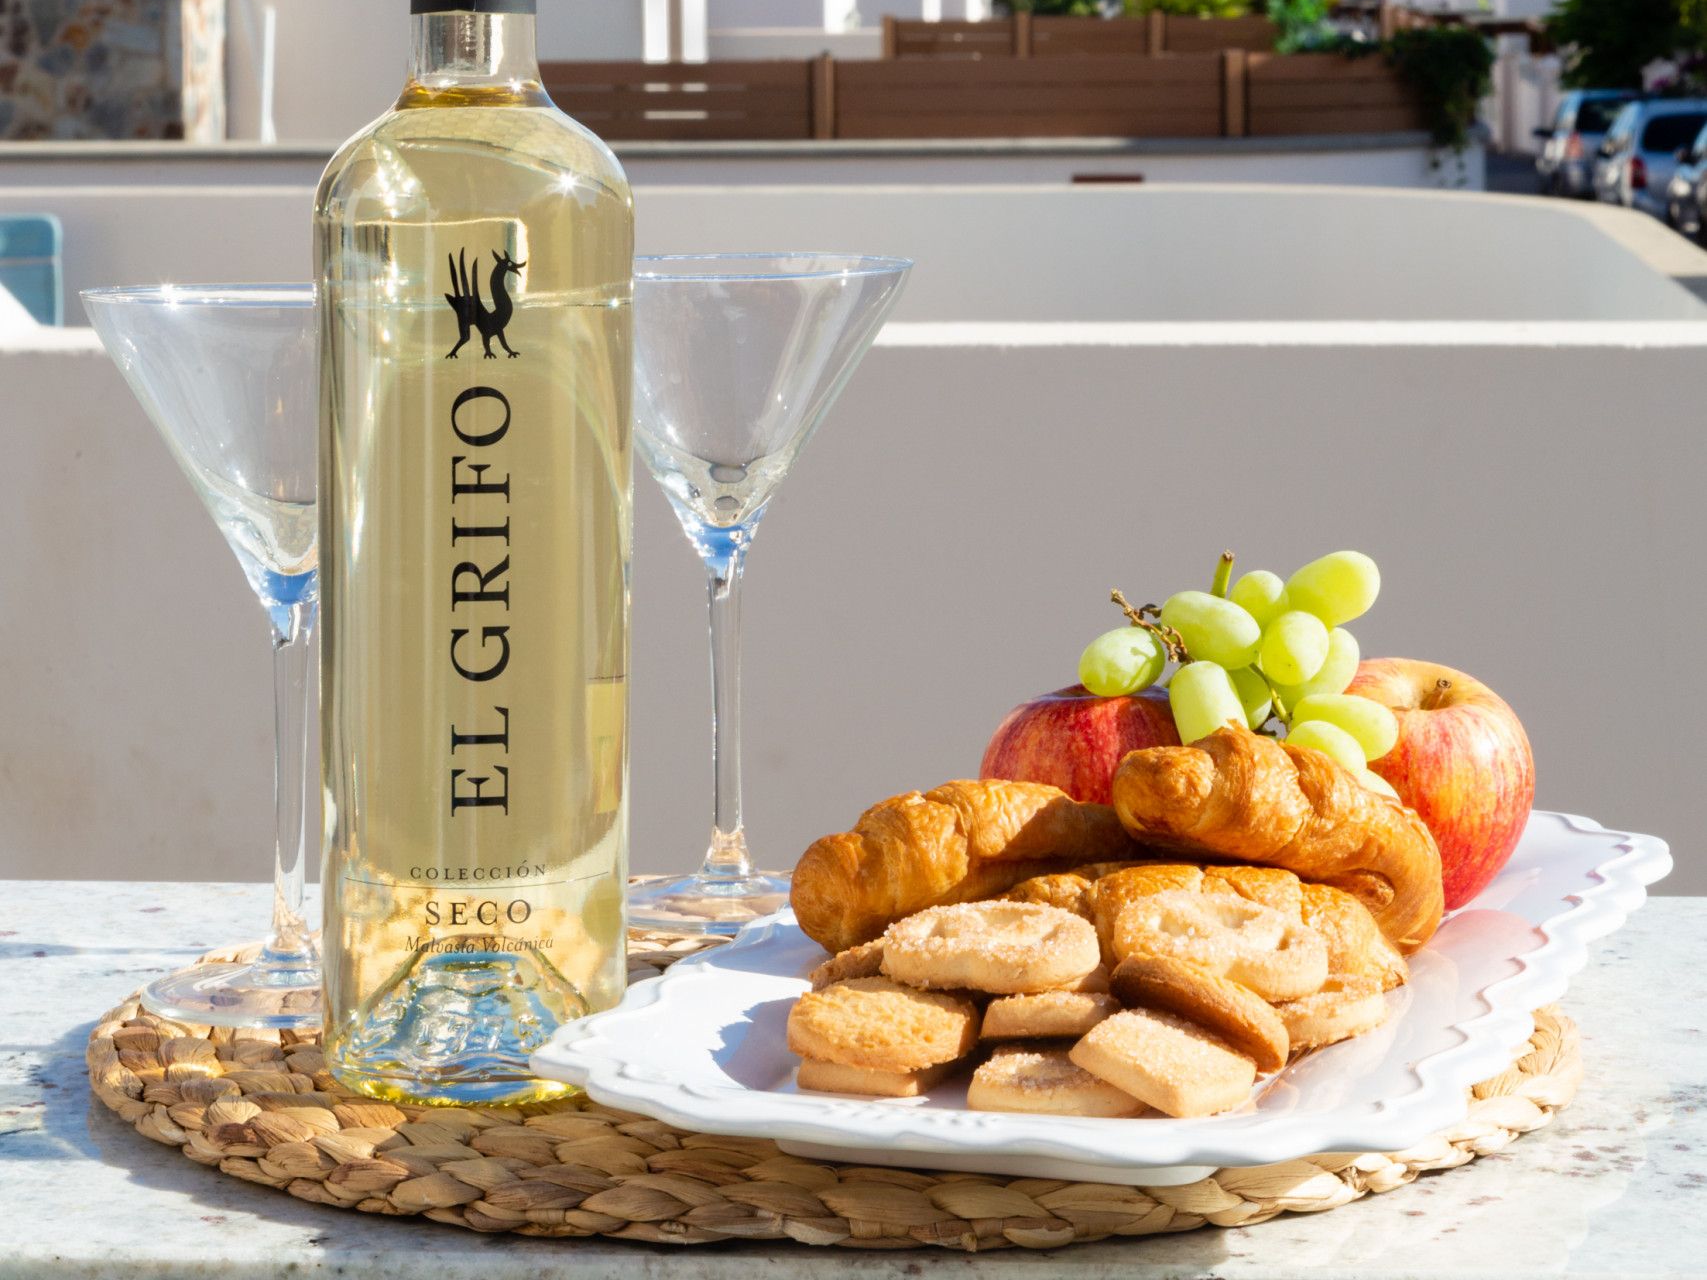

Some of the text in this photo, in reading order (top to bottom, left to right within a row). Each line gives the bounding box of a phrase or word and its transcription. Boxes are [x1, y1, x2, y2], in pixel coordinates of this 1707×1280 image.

[451, 386, 511, 817] EL GRIFO
[410, 860, 546, 881] COLECCIÓN
[425, 899, 532, 926] SECO
[405, 935, 553, 954] Malvasía Volcánica
